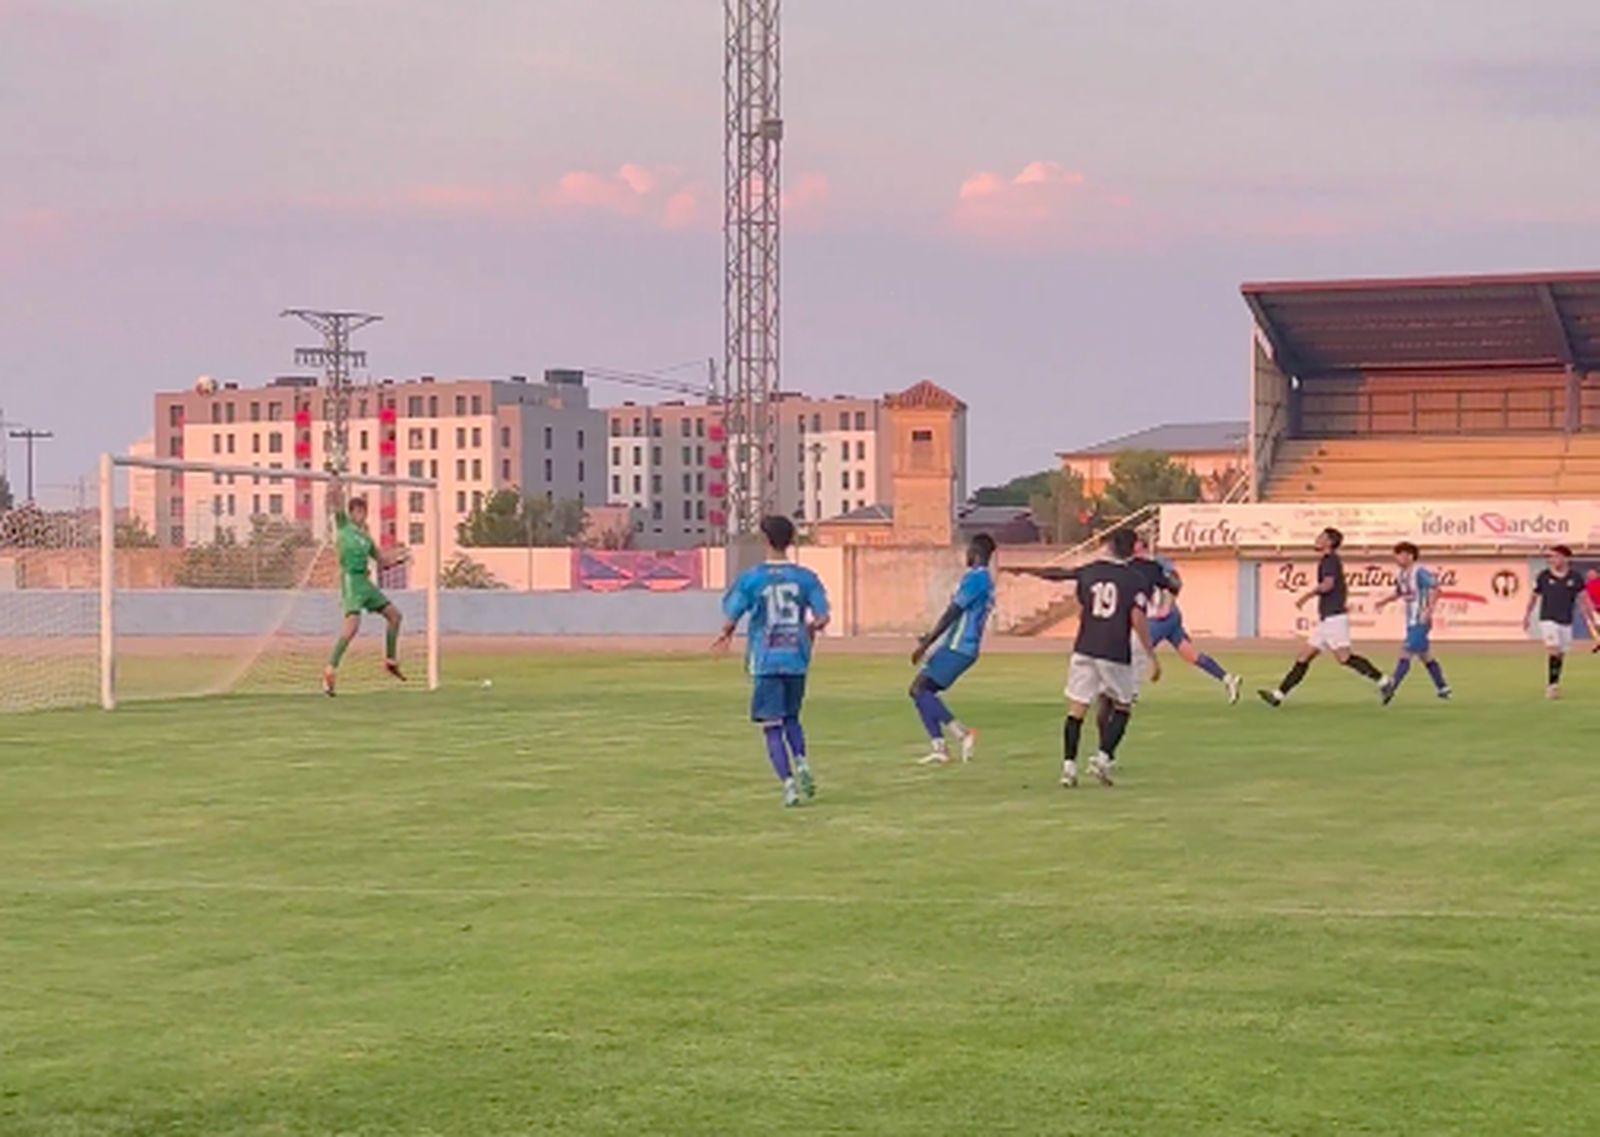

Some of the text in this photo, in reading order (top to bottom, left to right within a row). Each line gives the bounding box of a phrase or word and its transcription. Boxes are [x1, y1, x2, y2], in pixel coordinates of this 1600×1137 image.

[1421, 511, 1475, 534] ideal
[1277, 563, 1308, 593] La
[1091, 581, 1119, 618] 19
